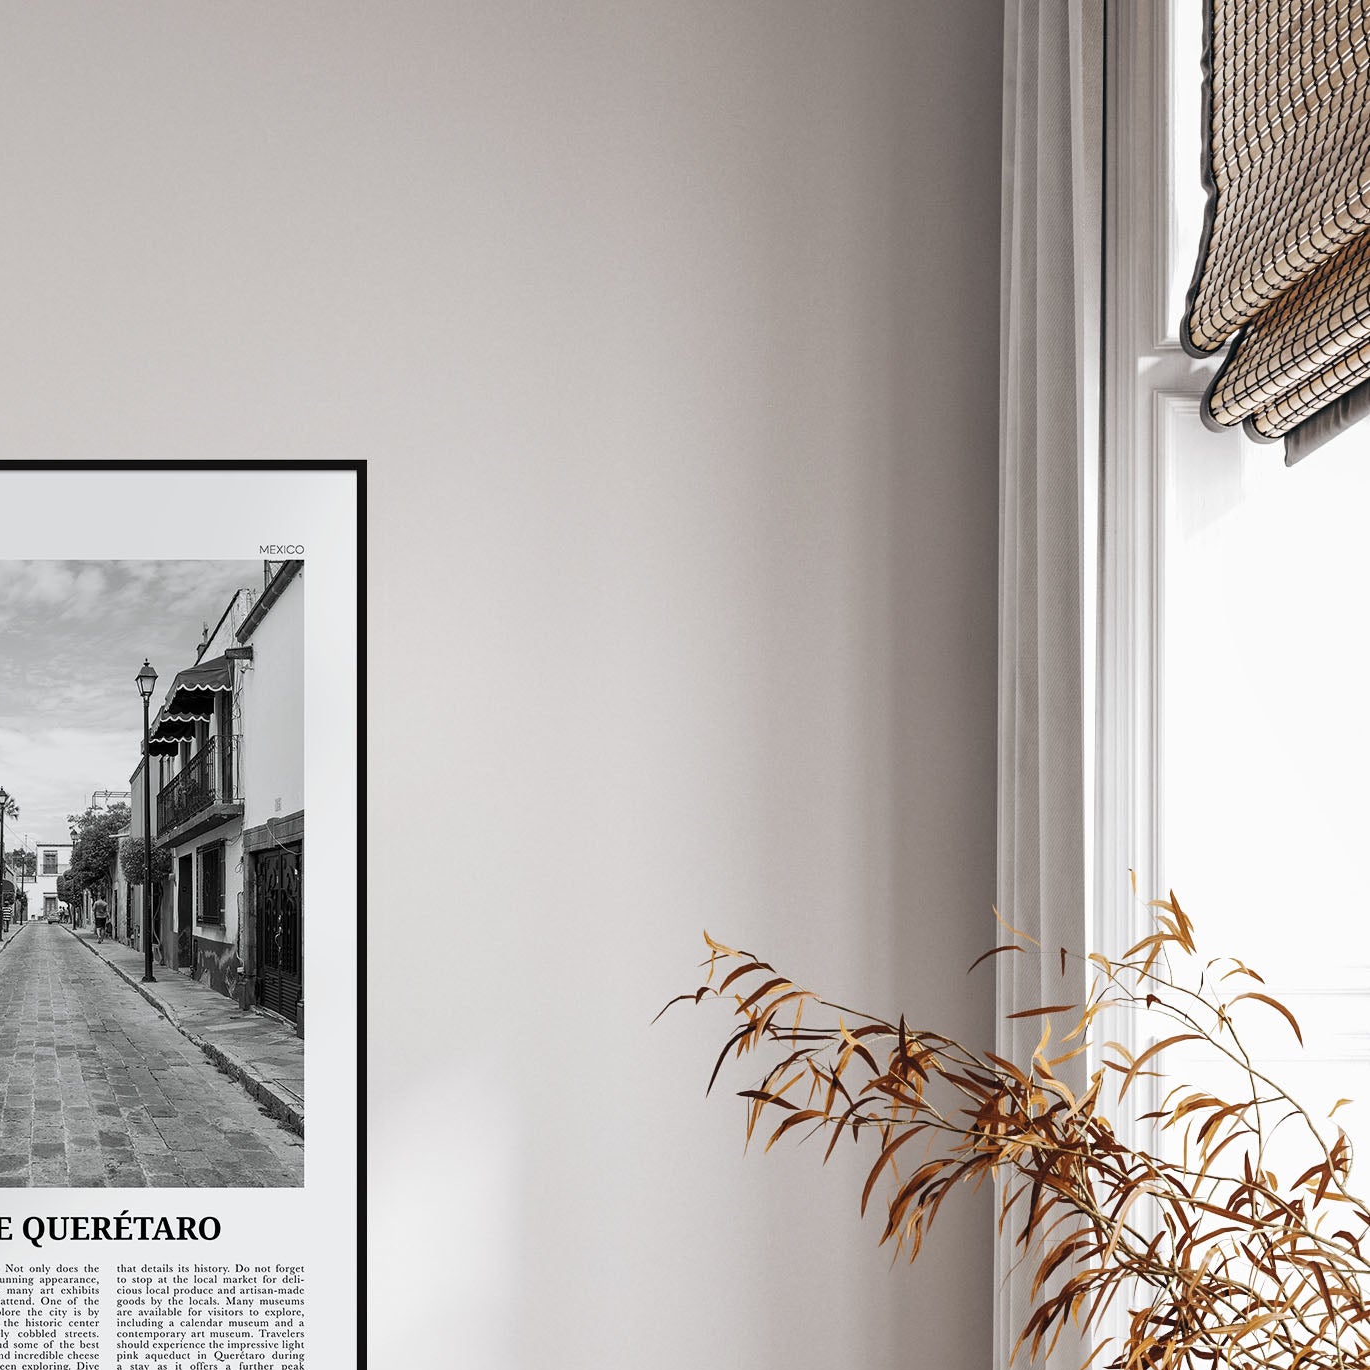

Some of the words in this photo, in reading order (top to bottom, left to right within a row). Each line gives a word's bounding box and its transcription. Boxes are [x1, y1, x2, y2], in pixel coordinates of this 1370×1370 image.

[260, 545, 304, 554] MEXICO
[23, 1210, 221, 1248] QUERÉTARO
[5, 1264, 24, 1273] Not
[29, 1264, 51, 1276] only
[56, 1264, 78, 1273] does
[84, 1264, 99, 1273] the
[117, 1264, 136, 1273] that
[141, 1264, 173, 1273] details
[178, 1264, 189, 1273] its
[194, 1264, 230, 1276] history.
[235, 1264, 250, 1273] Do
[255, 1264, 271, 1273] not
[276, 1264, 304, 1276] forget
[39, 1276, 99, 1286] appearance,
[116, 1286, 142, 1295] cious
[146, 1286, 169, 1295] local
[173, 1286, 213, 1297] produce
[217, 1286, 236, 1295] and
[240, 1286, 304, 1295] artisan-made
[0, 1297, 35, 1305] attend.
[40, 1297, 62, 1305] One
[67, 1297, 78, 1305] of
[84, 1297, 99, 1305] the
[116, 1297, 145, 1308] goods
[151, 1297, 162, 1308] by
[168, 1297, 183, 1305] the
[189, 1297, 219, 1305] locals.
[226, 1297, 254, 1308] Many
[117, 1318, 163, 1330] including
[180, 1318, 223, 1327] calendar
[275, 1318, 293, 1327] and
[18, 1329, 56, 1338] cobbled
[65, 1329, 99, 1338] streets.
[116, 1329, 186, 1341] contemporary
[191, 1329, 205, 1338] art
[258, 1329, 305, 1338] Travelers
[13, 1341, 38, 1349] some
[43, 1340, 54, 1349] of
[59, 1340, 75, 1349] the
[80, 1340, 99, 1349] best
[116, 1340, 149, 1349] should
[152, 1340, 206, 1352] experience
[209, 1340, 224, 1349] the
[227, 1340, 279, 1352] impressive
[282, 1340, 304, 1352] light
[117, 1351, 138, 1362] pink
[145, 1351, 190, 1362] aqueduct
[197, 1351, 207, 1360] in
[214, 1351, 265, 1362] Querétaro
[272, 1351, 305, 1362] during
